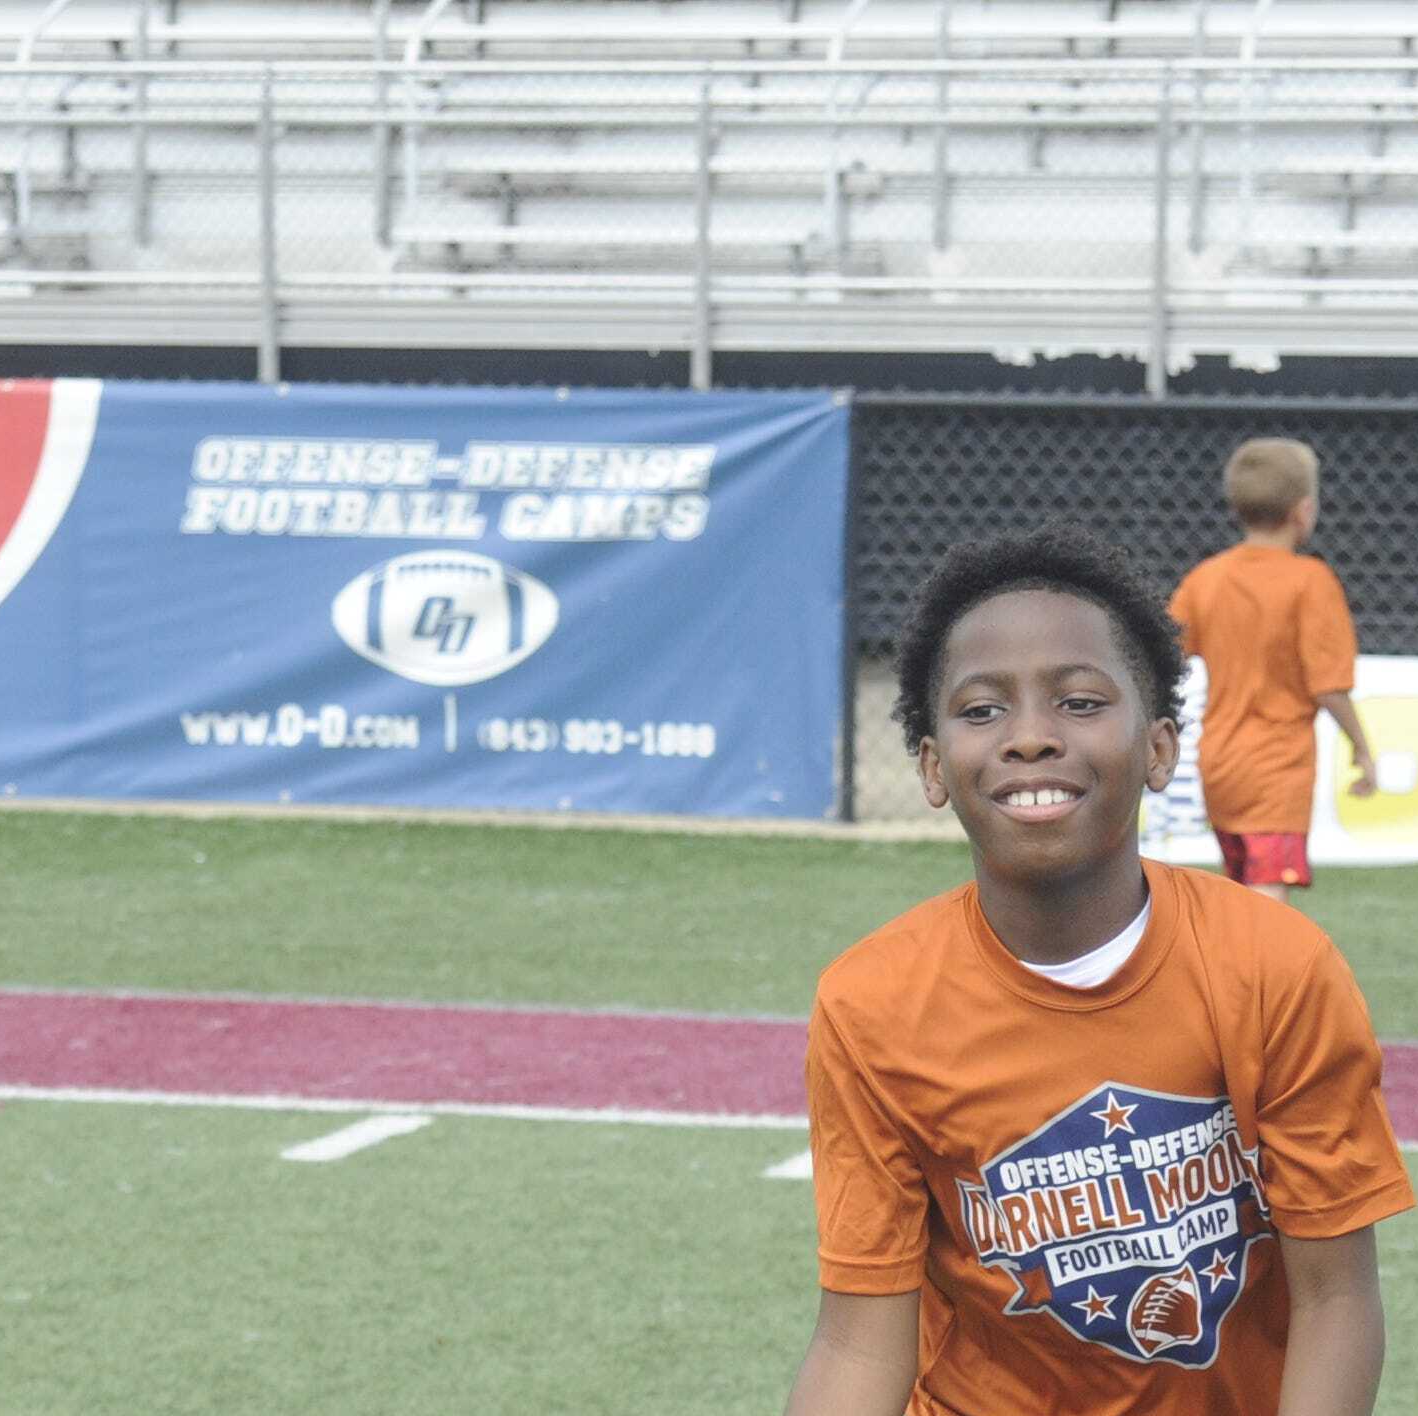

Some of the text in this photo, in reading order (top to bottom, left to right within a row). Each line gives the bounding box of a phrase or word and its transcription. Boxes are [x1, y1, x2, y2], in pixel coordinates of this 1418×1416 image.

[191, 435, 718, 493] OFFENSE-DEFENSE
[181, 485, 710, 542] FOOTBALL CAMPS
[999, 1104, 1238, 1191] OFFENSE-DEFENSE
[1056, 1207, 1229, 1278] FOOTBALL CAMP
